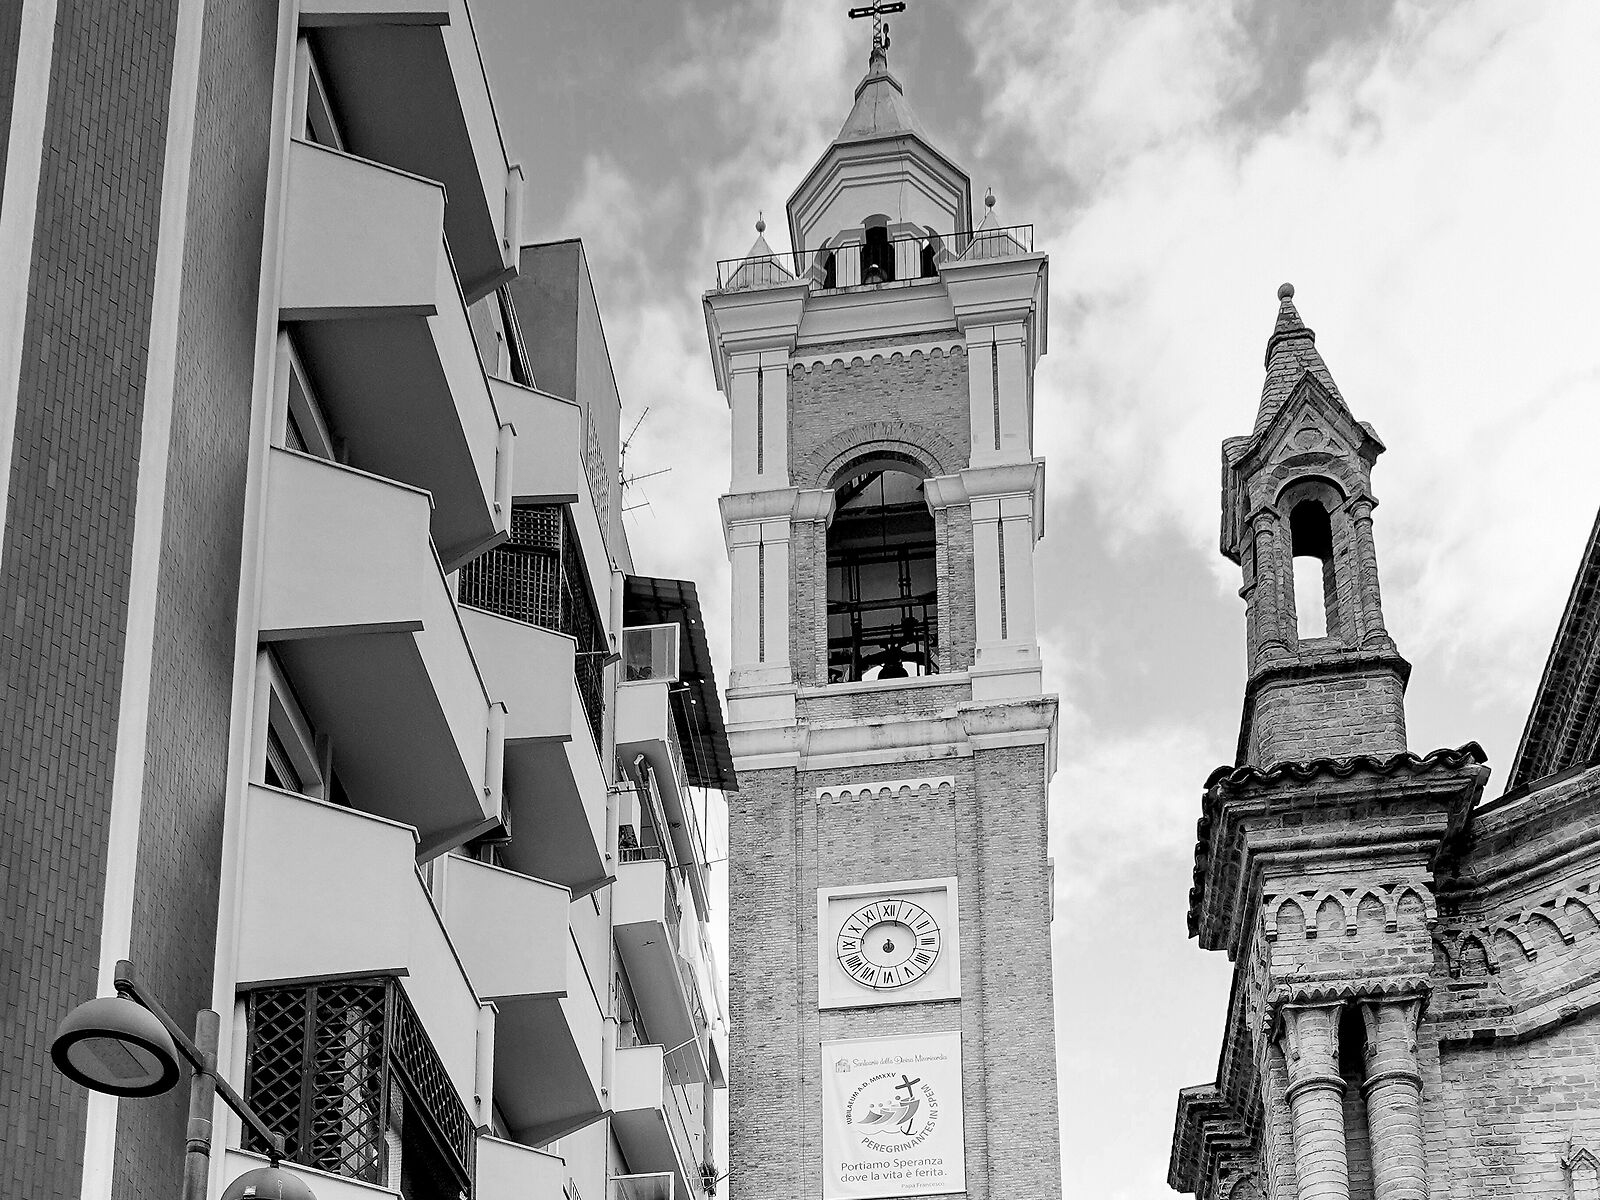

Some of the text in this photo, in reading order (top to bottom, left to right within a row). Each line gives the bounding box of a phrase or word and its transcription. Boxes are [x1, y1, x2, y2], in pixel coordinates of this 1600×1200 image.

[862, 909, 876, 923] XI
[883, 904, 896, 917] XII
[848, 924, 862, 934] X
[916, 920, 930, 930] II
[842, 941, 856, 951] IX
[921, 937, 936, 946] III
[845, 955, 863, 972] VIII
[914, 952, 931, 965] IIII
[860, 966, 875, 982] VII
[884, 971, 894, 984] VI
[904, 966, 914, 979] V
[861, 1083, 939, 1154] PEREGRINANTES IN SPEM
[841, 1158, 943, 1172] Portiamo Speranza
[840, 1168, 948, 1183] dove la vita è ferita.
